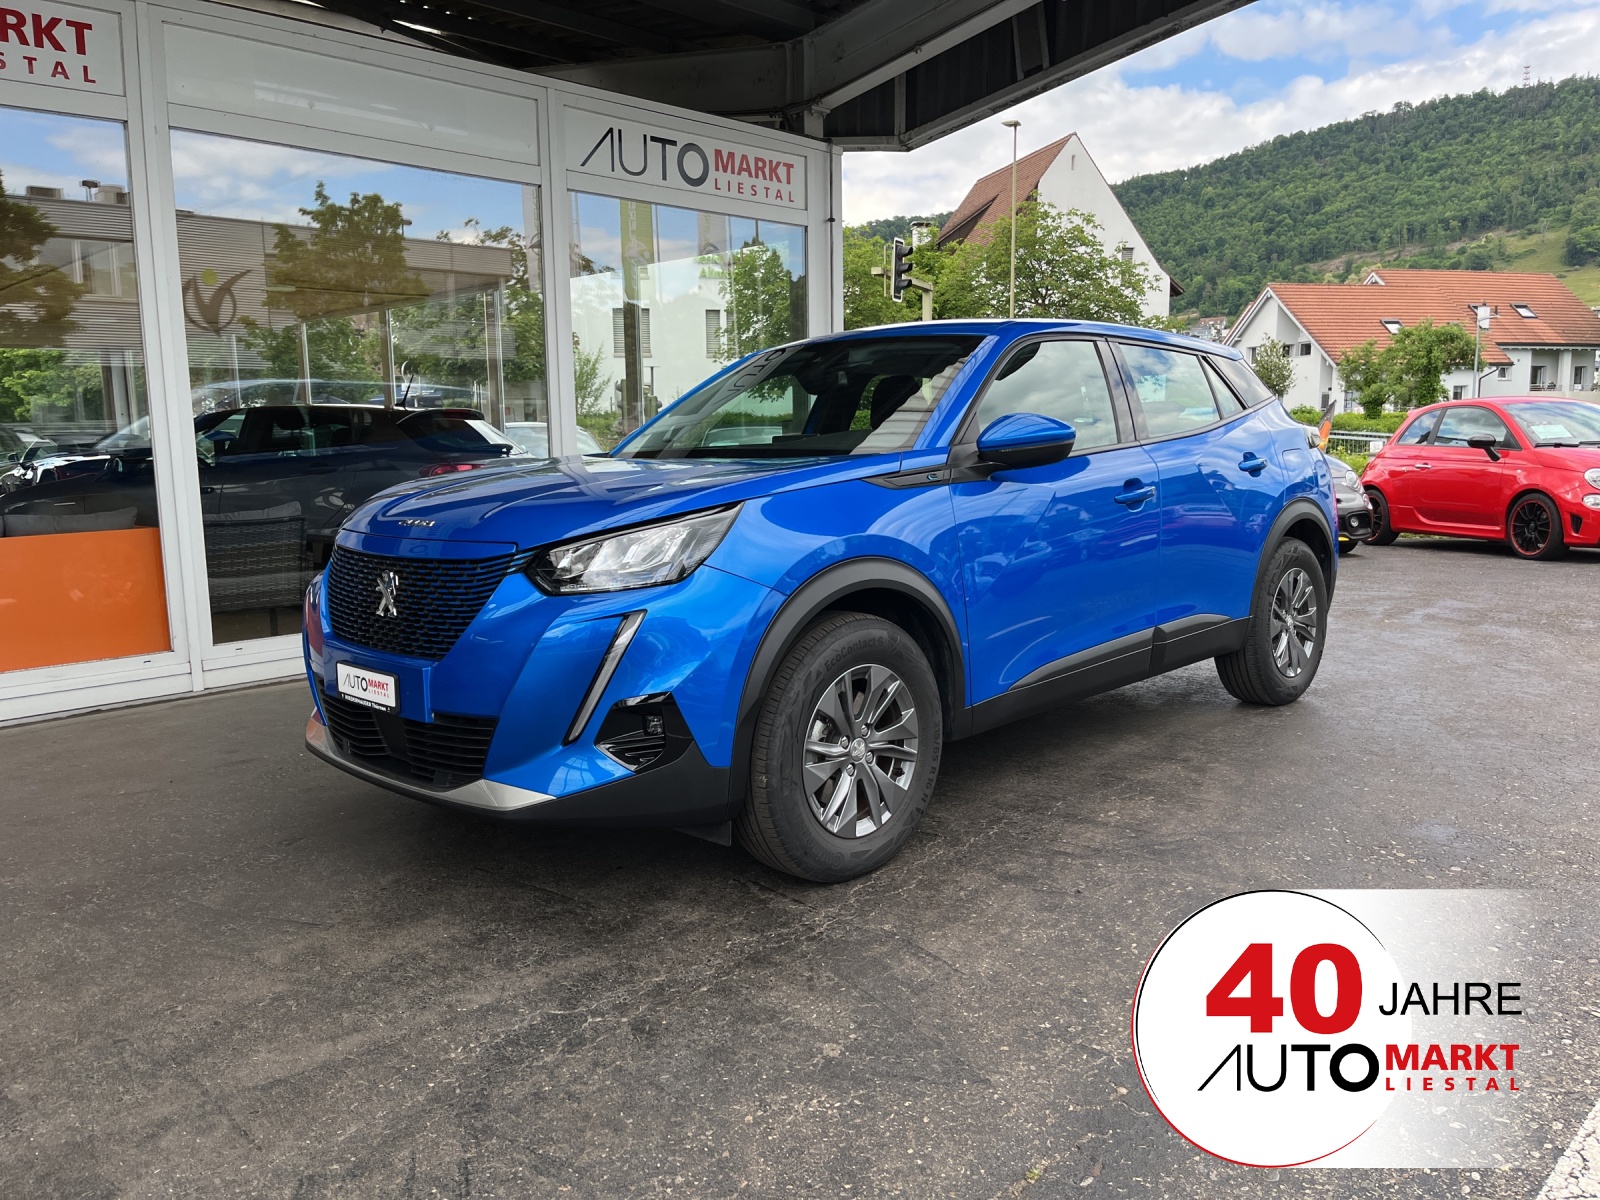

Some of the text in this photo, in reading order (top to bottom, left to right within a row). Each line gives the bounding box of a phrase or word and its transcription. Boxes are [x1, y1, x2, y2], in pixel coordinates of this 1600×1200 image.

[580, 126, 795, 187] AUTO MARKT
[714, 177, 795, 203] LIESTAL
[824, 636, 885, 672] EcoContact 6
[343, 673, 389, 692] AUTO MARKT
